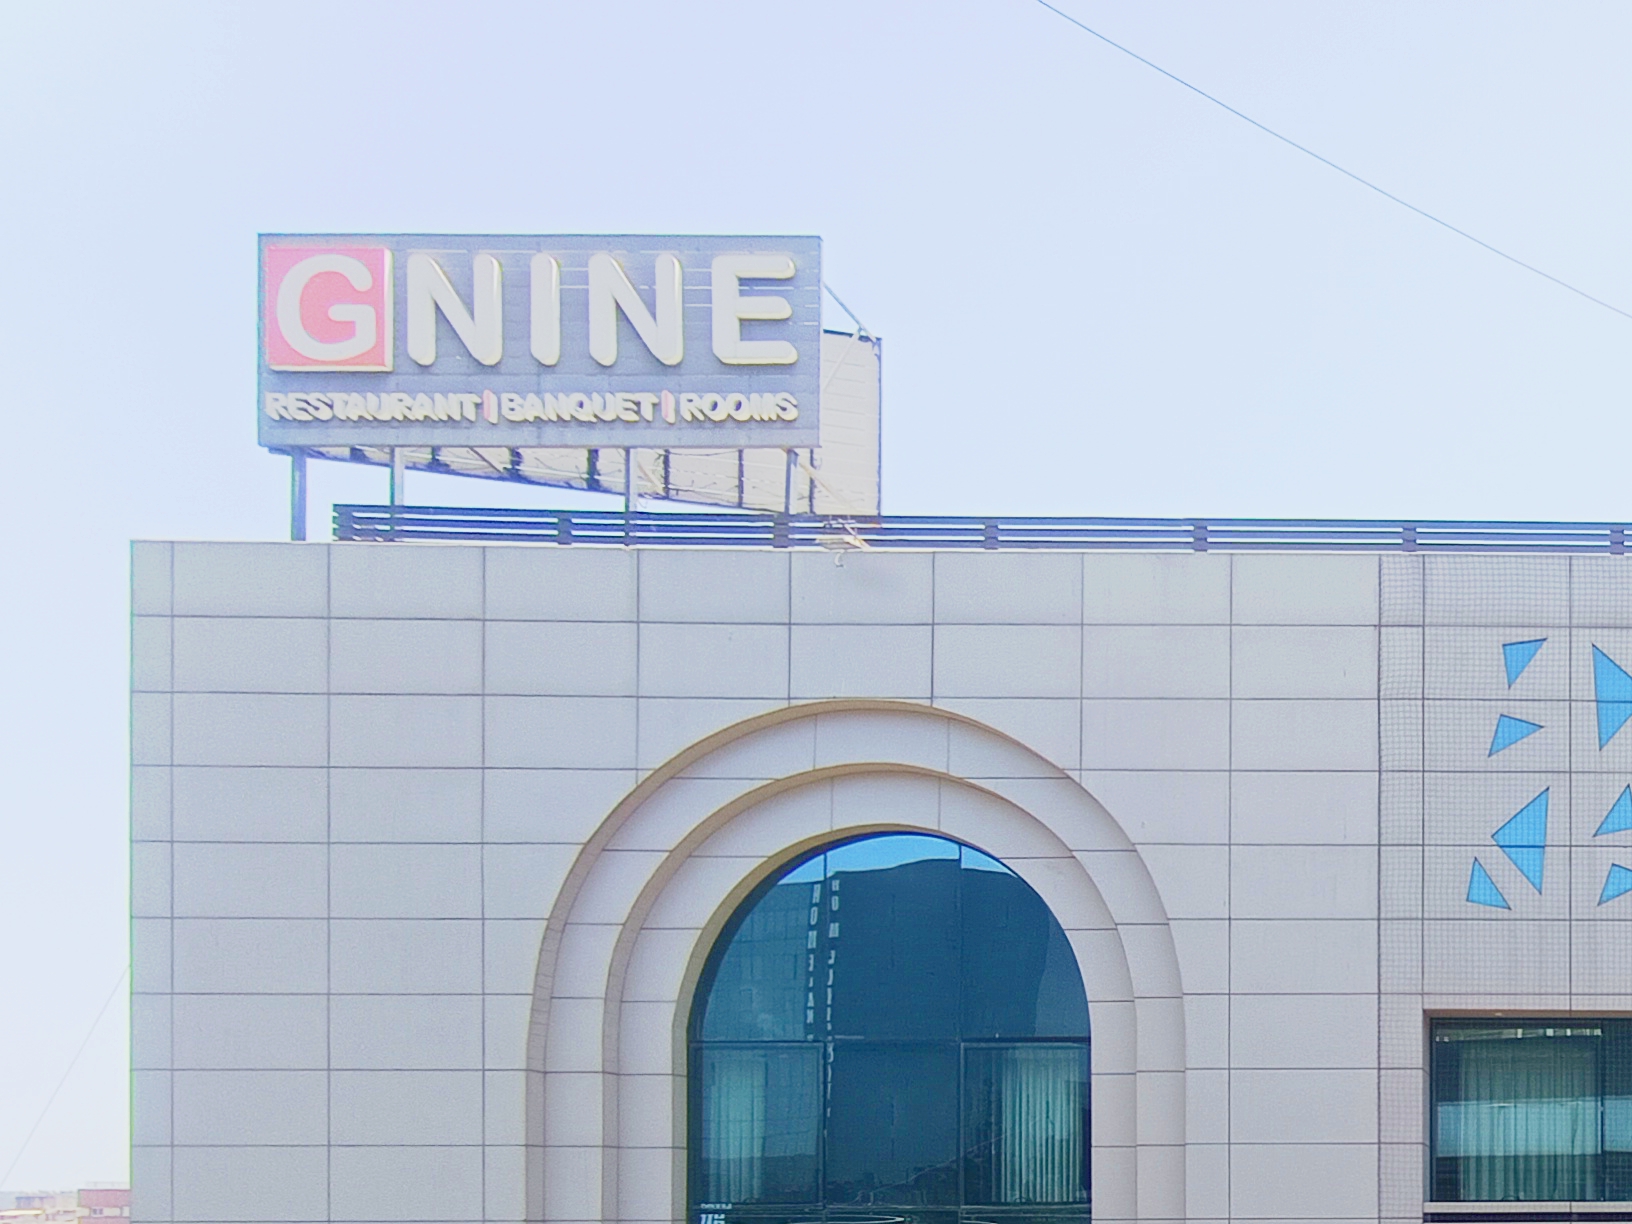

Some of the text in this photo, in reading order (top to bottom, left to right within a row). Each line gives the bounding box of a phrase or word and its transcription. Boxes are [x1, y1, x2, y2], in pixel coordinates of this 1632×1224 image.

[265, 391, 798, 422] RESTAURANT BANQUET ROOMS
